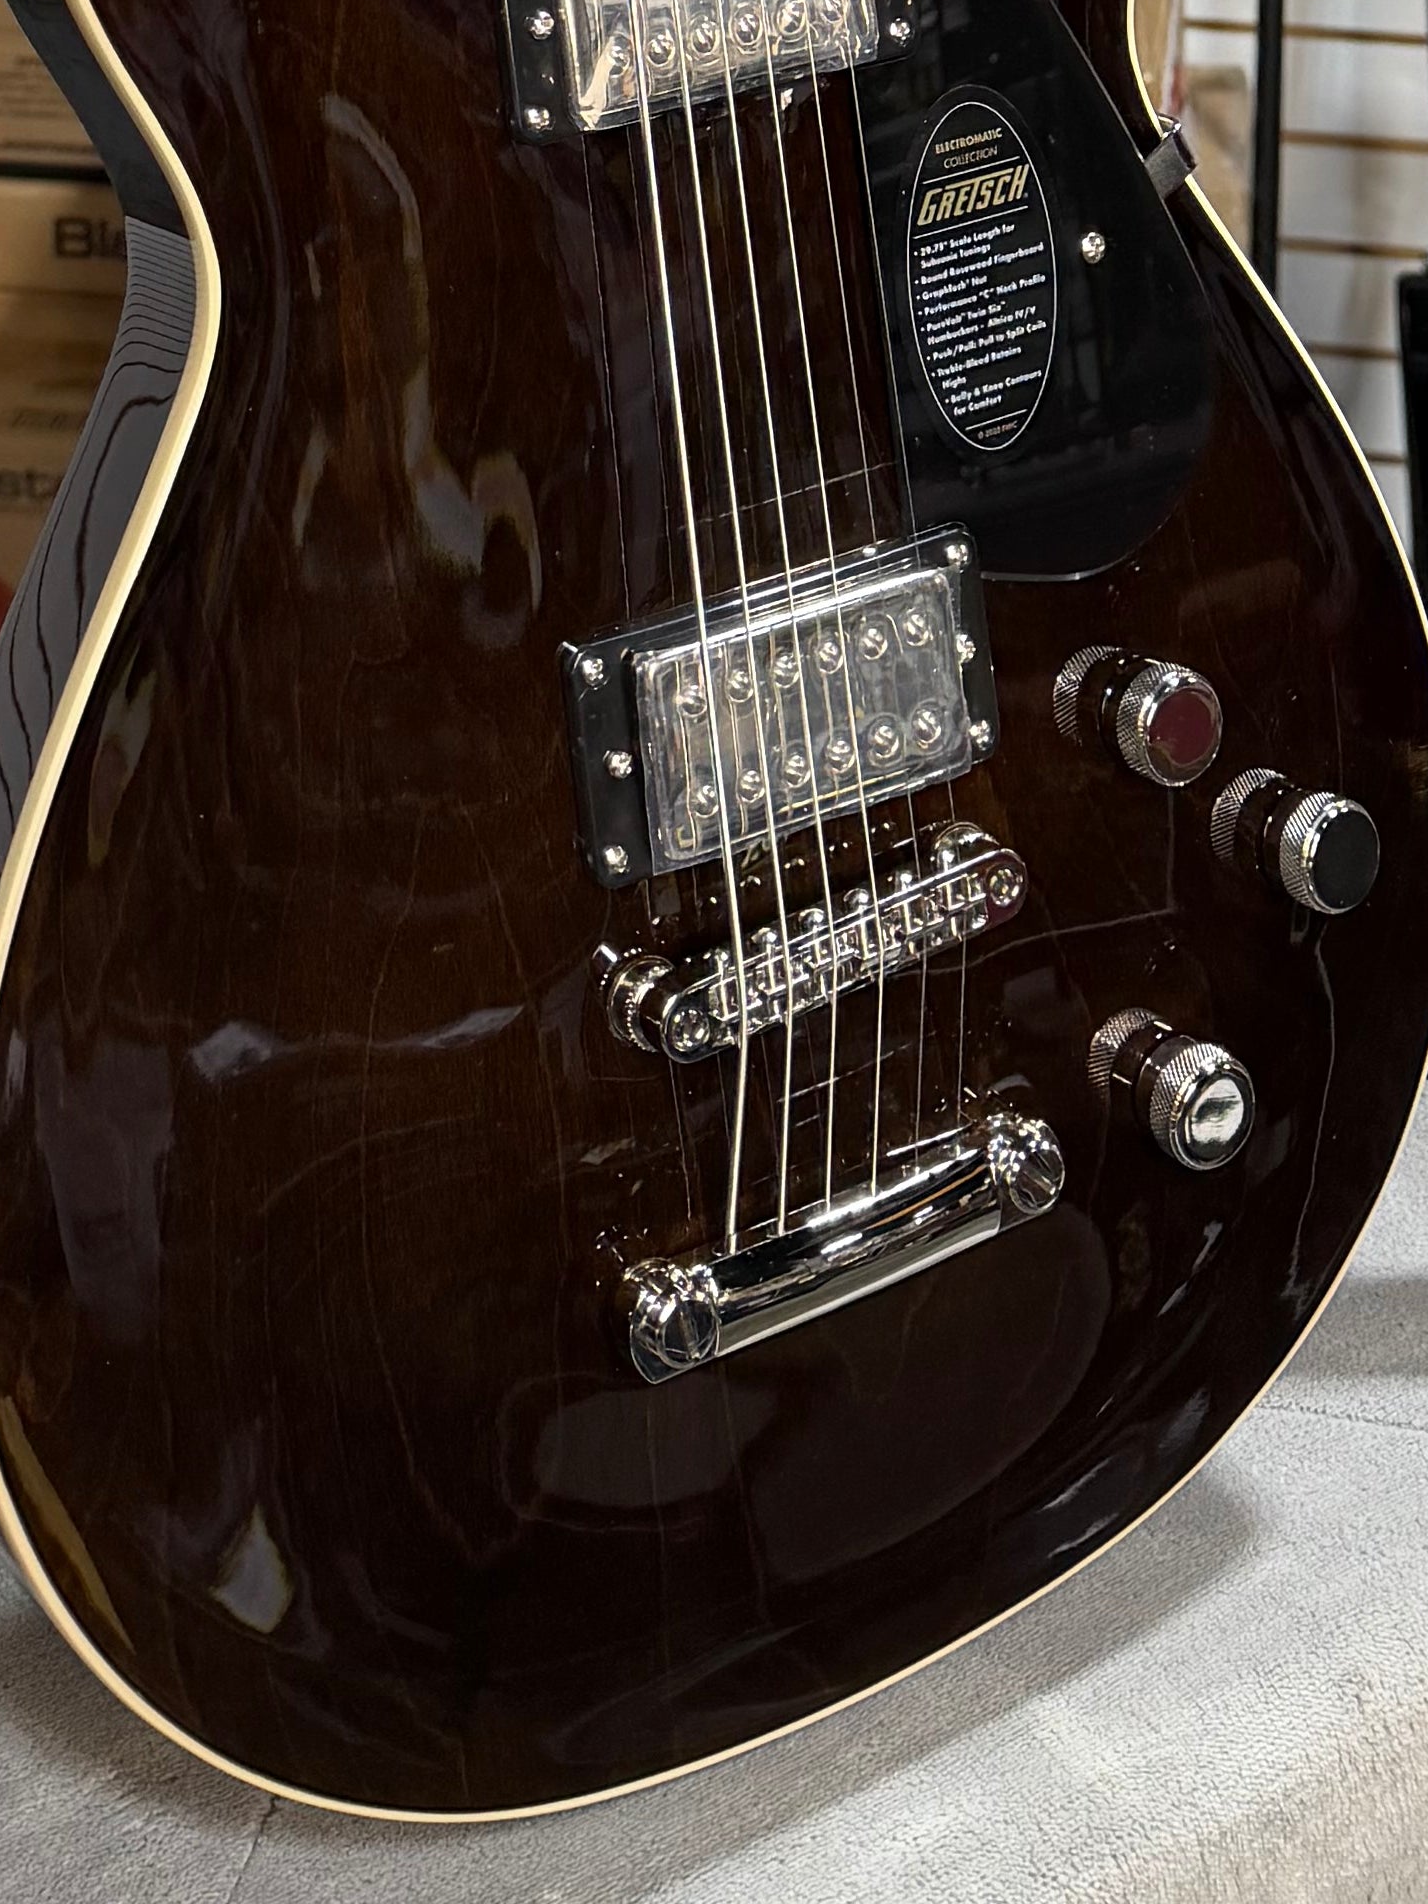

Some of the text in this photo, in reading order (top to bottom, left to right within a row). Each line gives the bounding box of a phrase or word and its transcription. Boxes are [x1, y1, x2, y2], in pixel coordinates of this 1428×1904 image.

[935, 127, 1003, 154] ELECTROMATIC
[943, 145, 998, 169] COLLECTION
[917, 164, 1030, 226] GRETSCH
